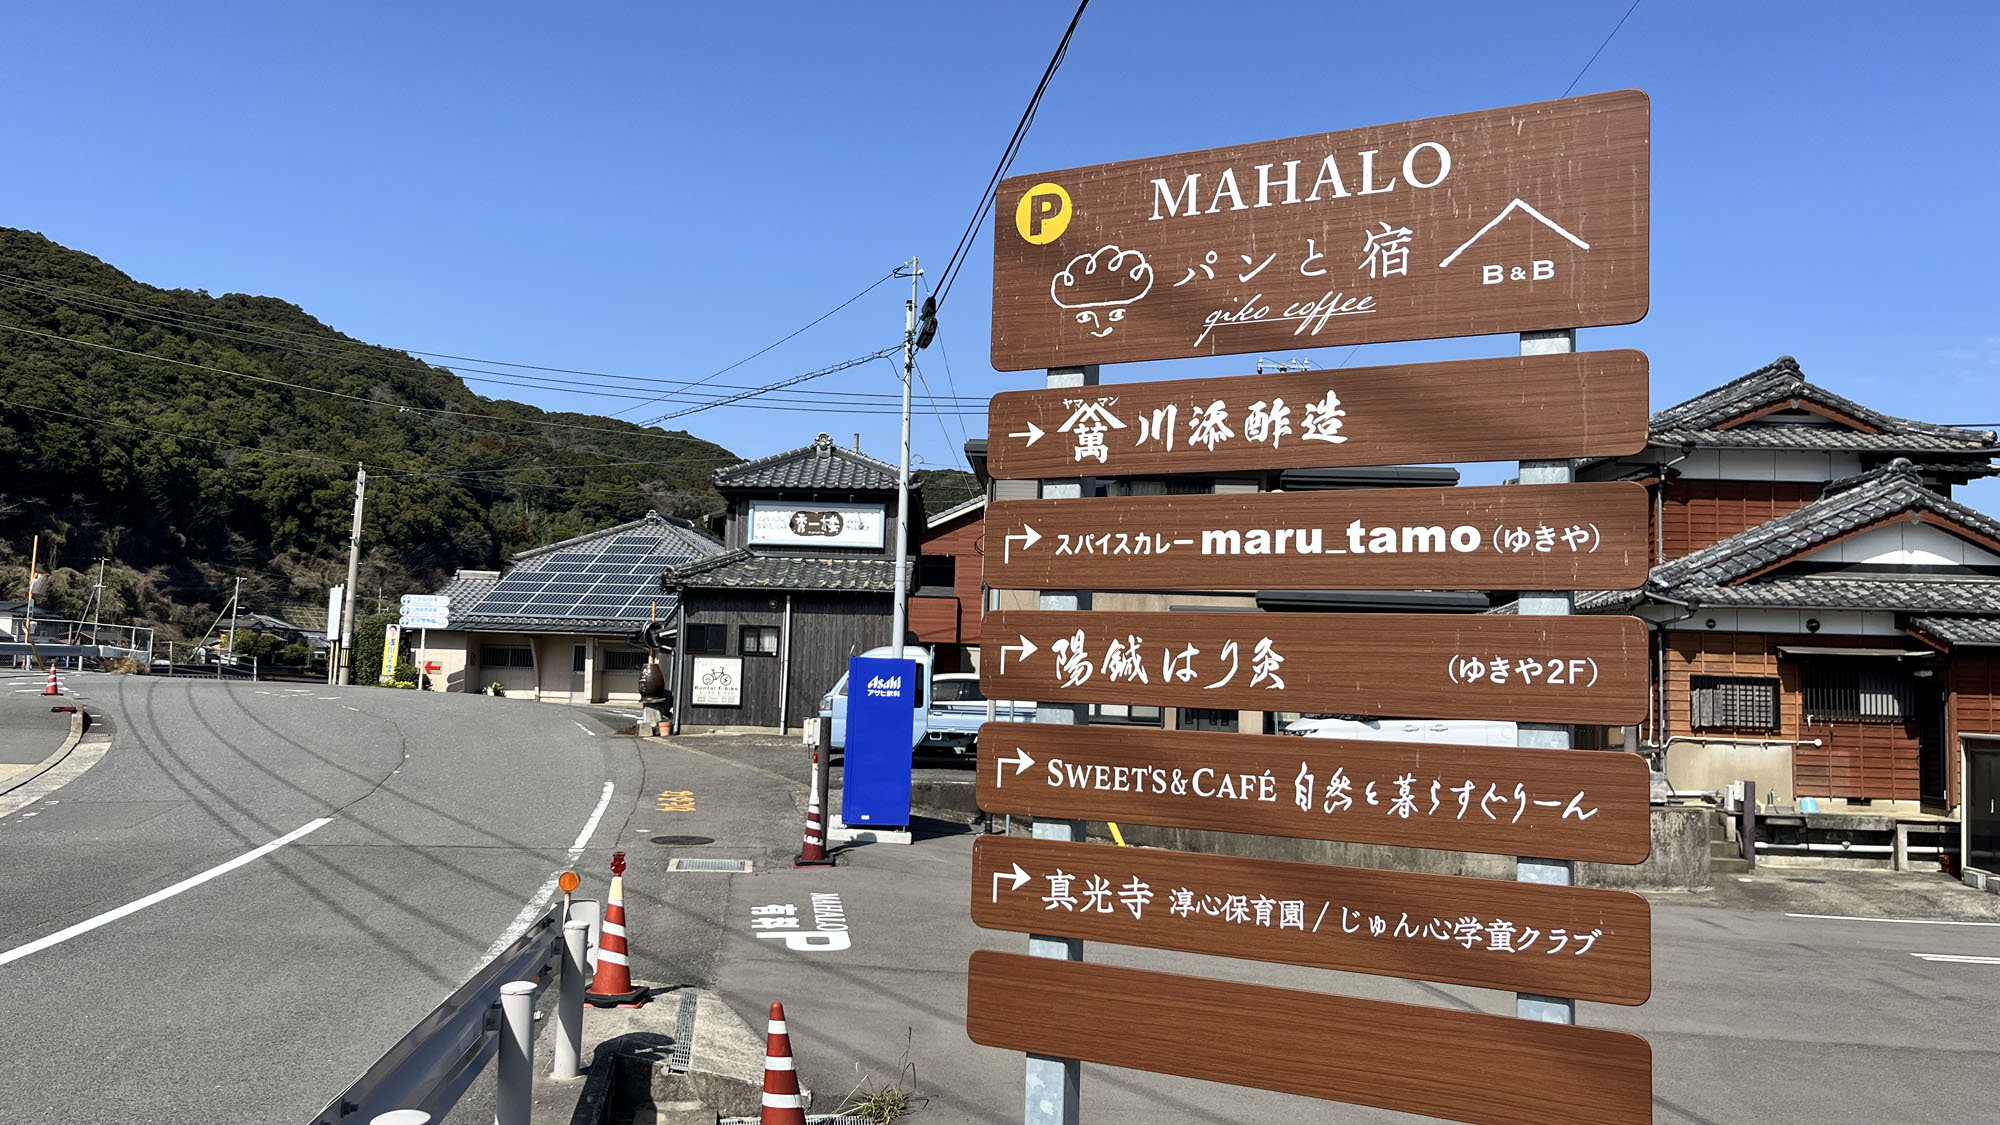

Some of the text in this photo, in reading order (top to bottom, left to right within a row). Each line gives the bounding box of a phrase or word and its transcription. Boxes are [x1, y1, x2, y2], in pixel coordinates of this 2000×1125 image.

[1149, 141, 1452, 221] MAHALO
[1030, 193, 1063, 236] P
[1174, 221, 1414, 288] パンと宿
[1483, 259, 1556, 285] B&B
[1283, 290, 1377, 336] coffee
[1055, 519, 1601, 556] スパイスカレー maru_tamo (ゆきや)
[867, 675, 902, 690] Asahi
[1448, 654, 1598, 688] (ゆきや2F)
[1041, 868, 1155, 920] 真光寺
[756, 892, 851, 952] MAHALO P
